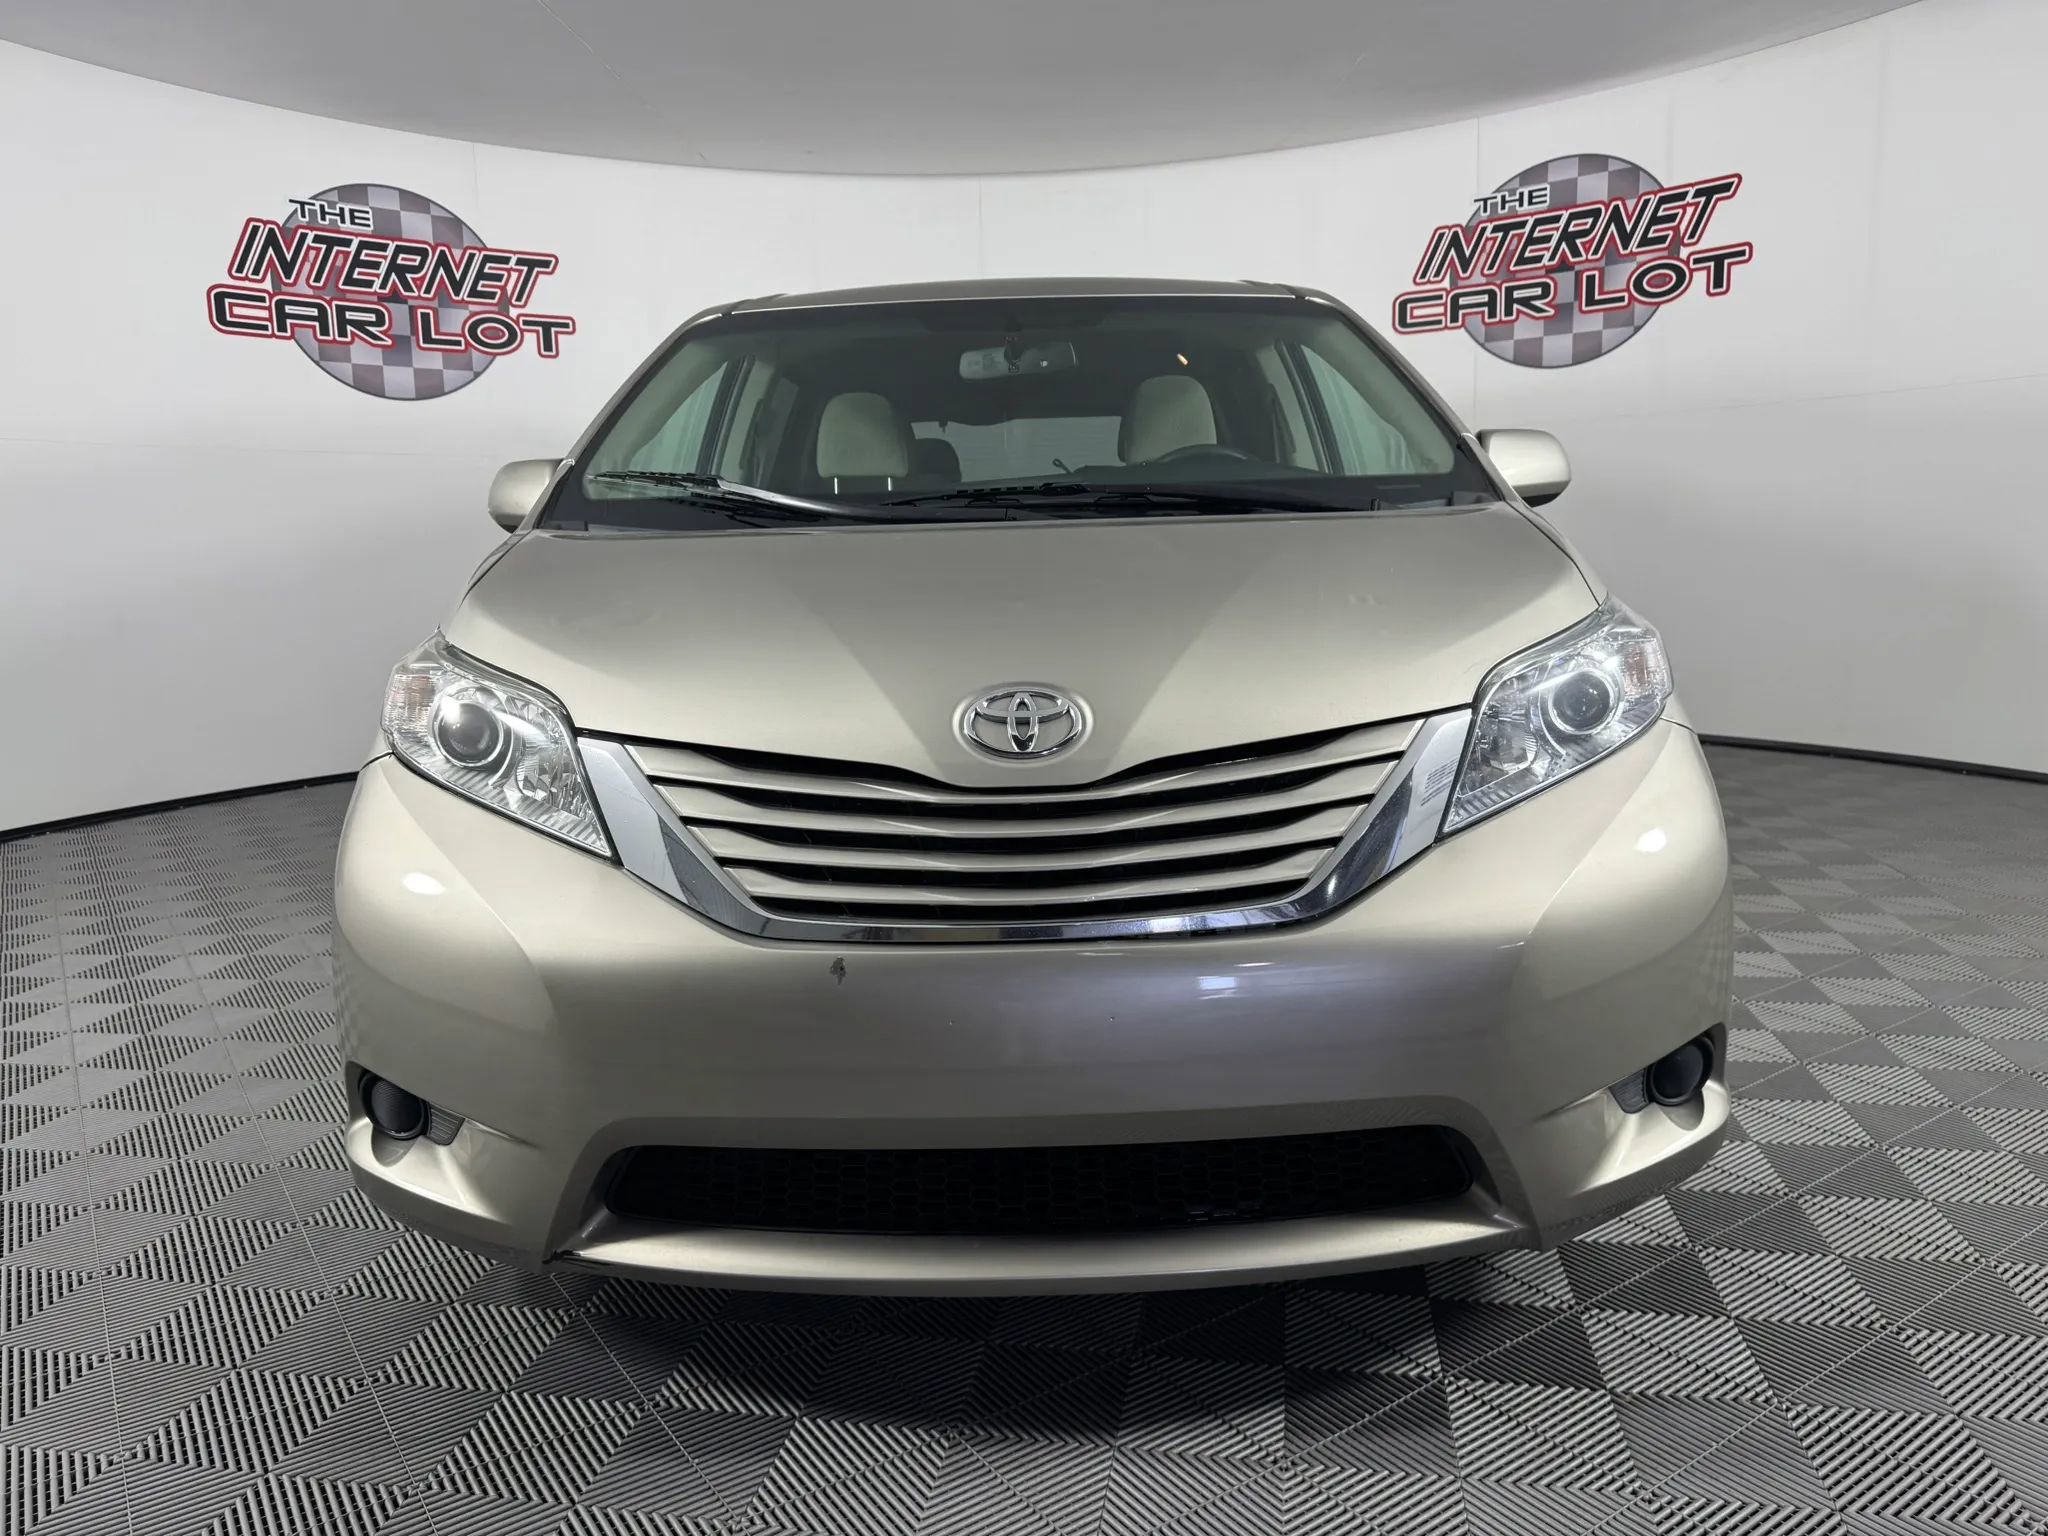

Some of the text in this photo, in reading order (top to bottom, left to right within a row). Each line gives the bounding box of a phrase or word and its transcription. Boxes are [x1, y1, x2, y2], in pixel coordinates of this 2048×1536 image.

[290, 199, 371, 228] THE
[1416, 176, 1739, 282] INTERNET
[1475, 185, 1550, 215] THE
[231, 220, 556, 301] INTERNET
[1396, 244, 1750, 331] CAR LOT
[210, 286, 573, 355] CAR LOT
